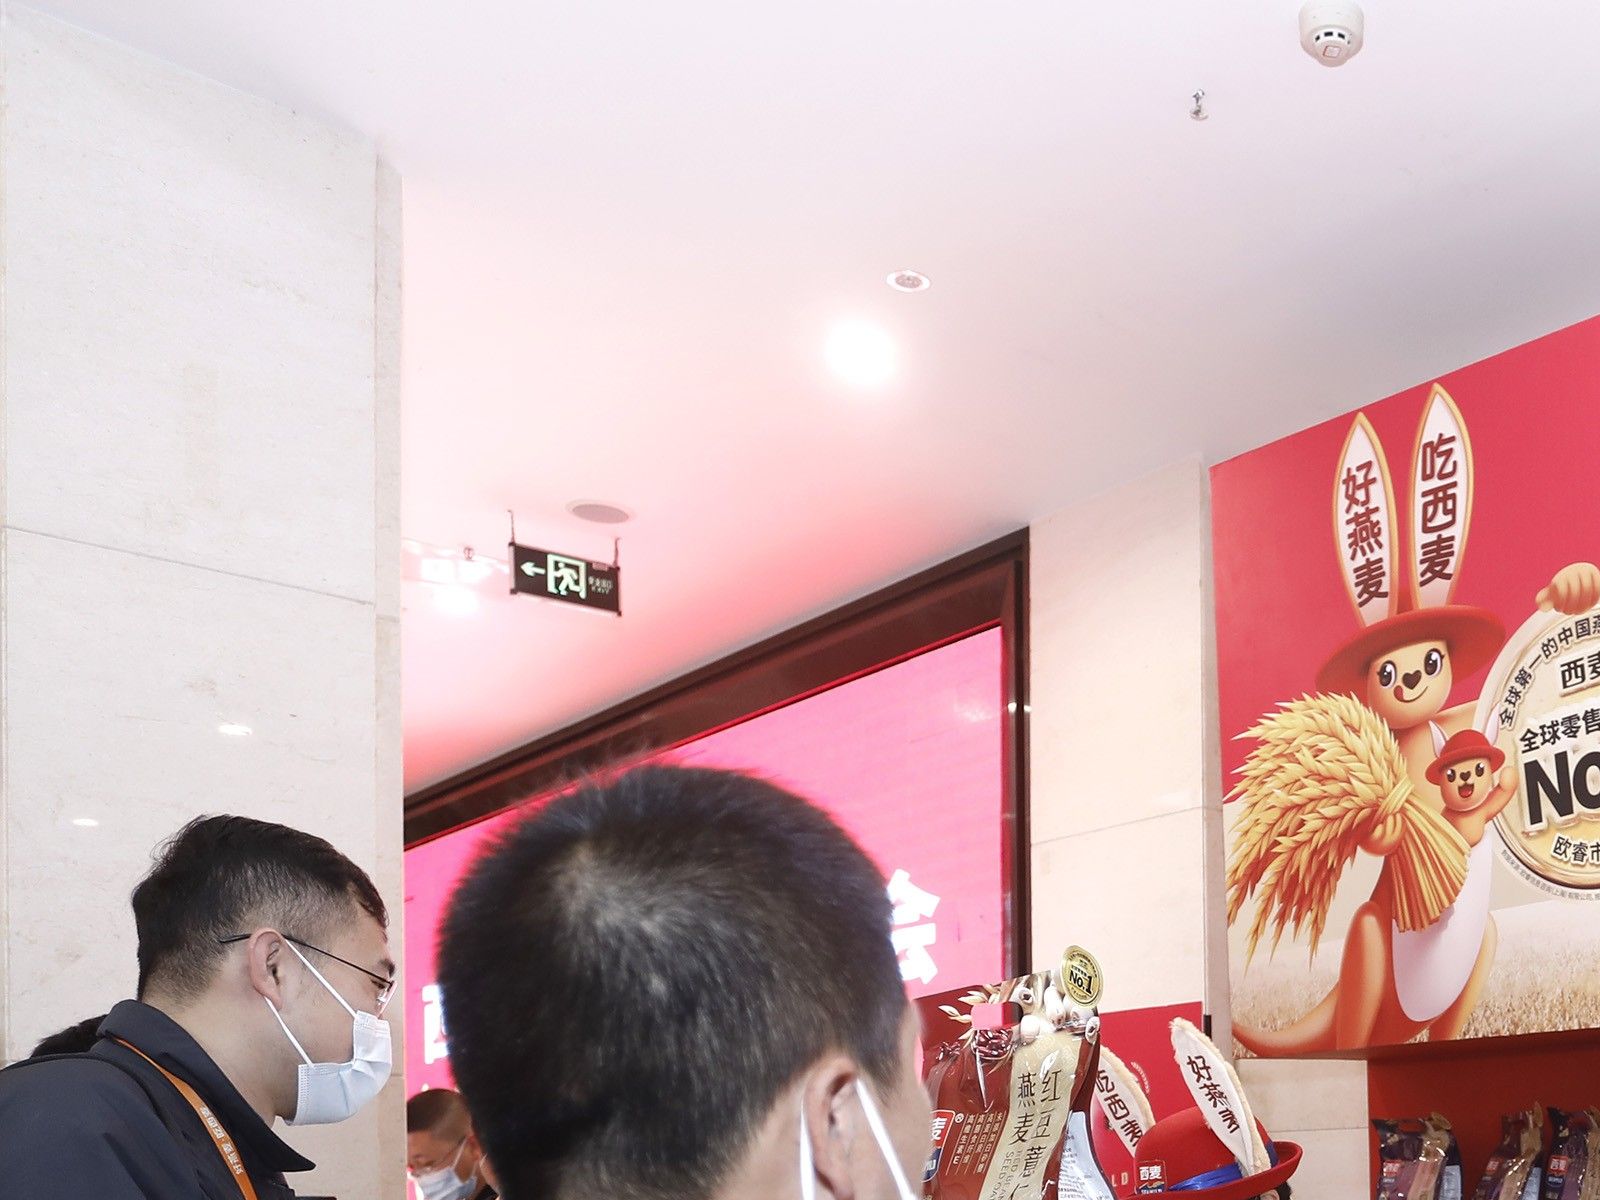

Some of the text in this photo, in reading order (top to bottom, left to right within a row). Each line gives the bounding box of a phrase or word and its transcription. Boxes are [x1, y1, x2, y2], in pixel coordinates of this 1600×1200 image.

[1342, 460, 1389, 607] 好燕麦
[1419, 432, 1459, 586] 吃西麦
[1009, 1072, 1036, 1146] 燕麦
[1187, 1055, 1240, 1134] 好燕麦
[999, 1151, 1015, 1179] SEED
